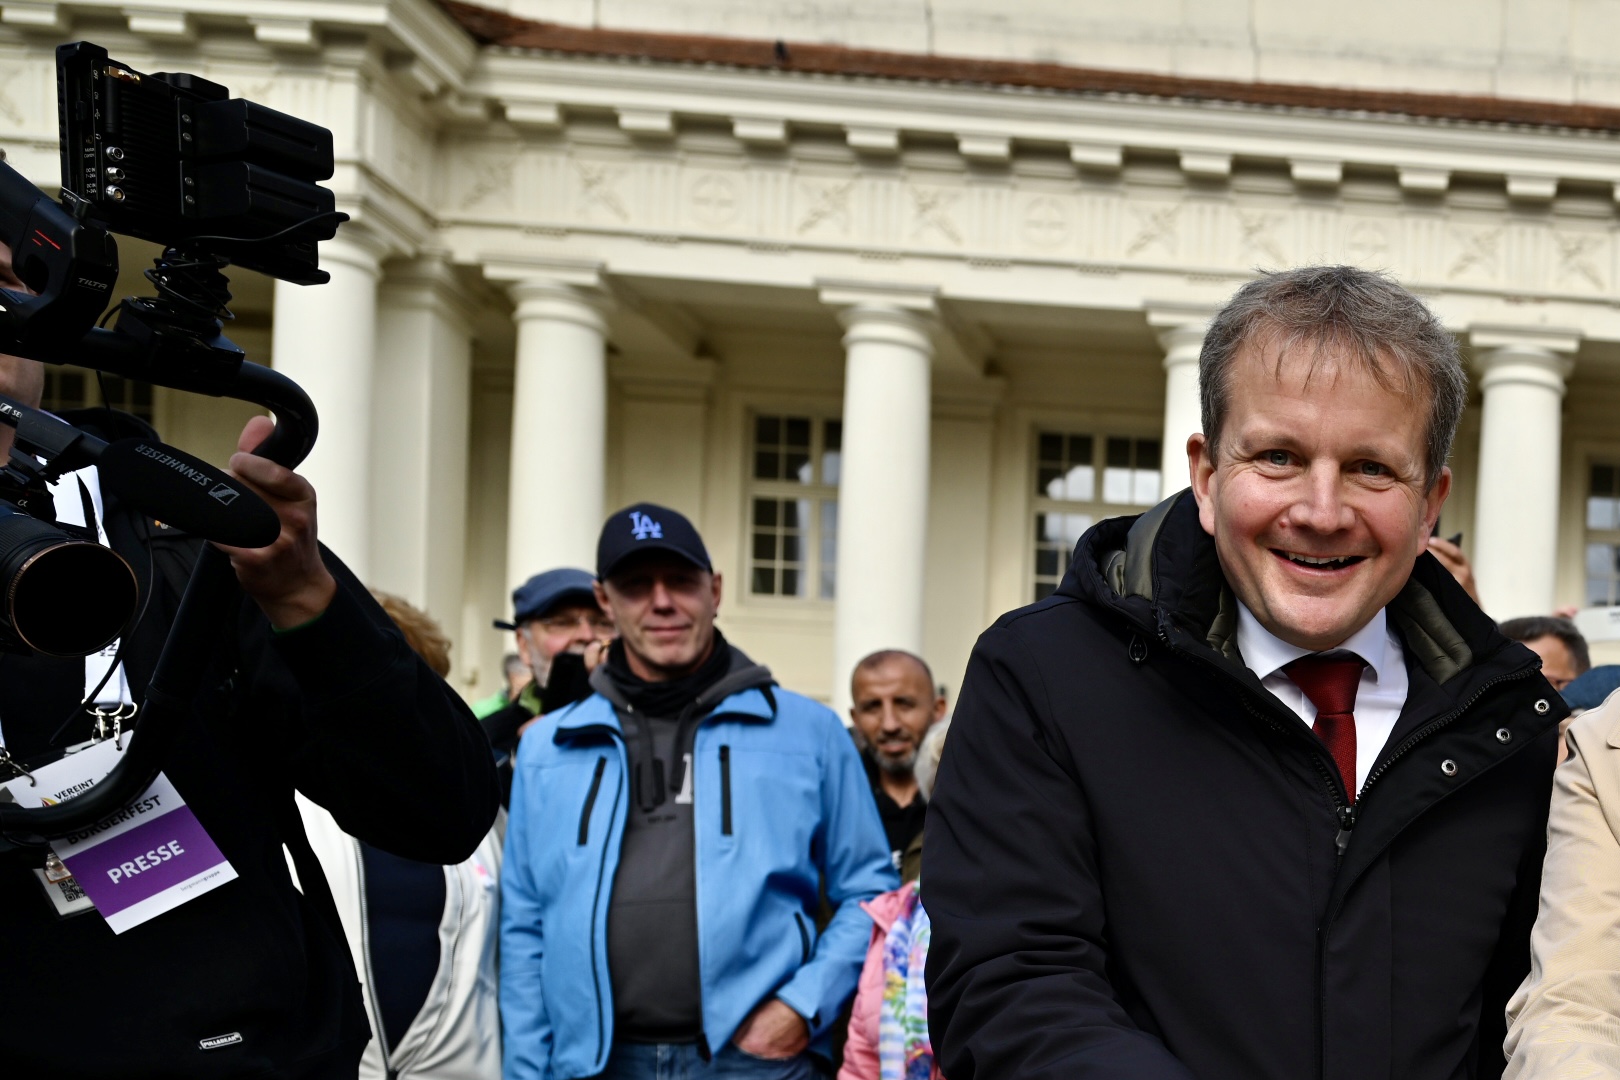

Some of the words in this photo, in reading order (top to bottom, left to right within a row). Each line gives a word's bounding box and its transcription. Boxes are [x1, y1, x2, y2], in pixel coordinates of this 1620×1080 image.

[78, 277, 108, 291] TILTA
[134, 442, 214, 488] SENNHEISER
[628, 510, 664, 541] LA
[54, 777, 95, 800] VEREINT
[107, 839, 185, 884] PRESSE
